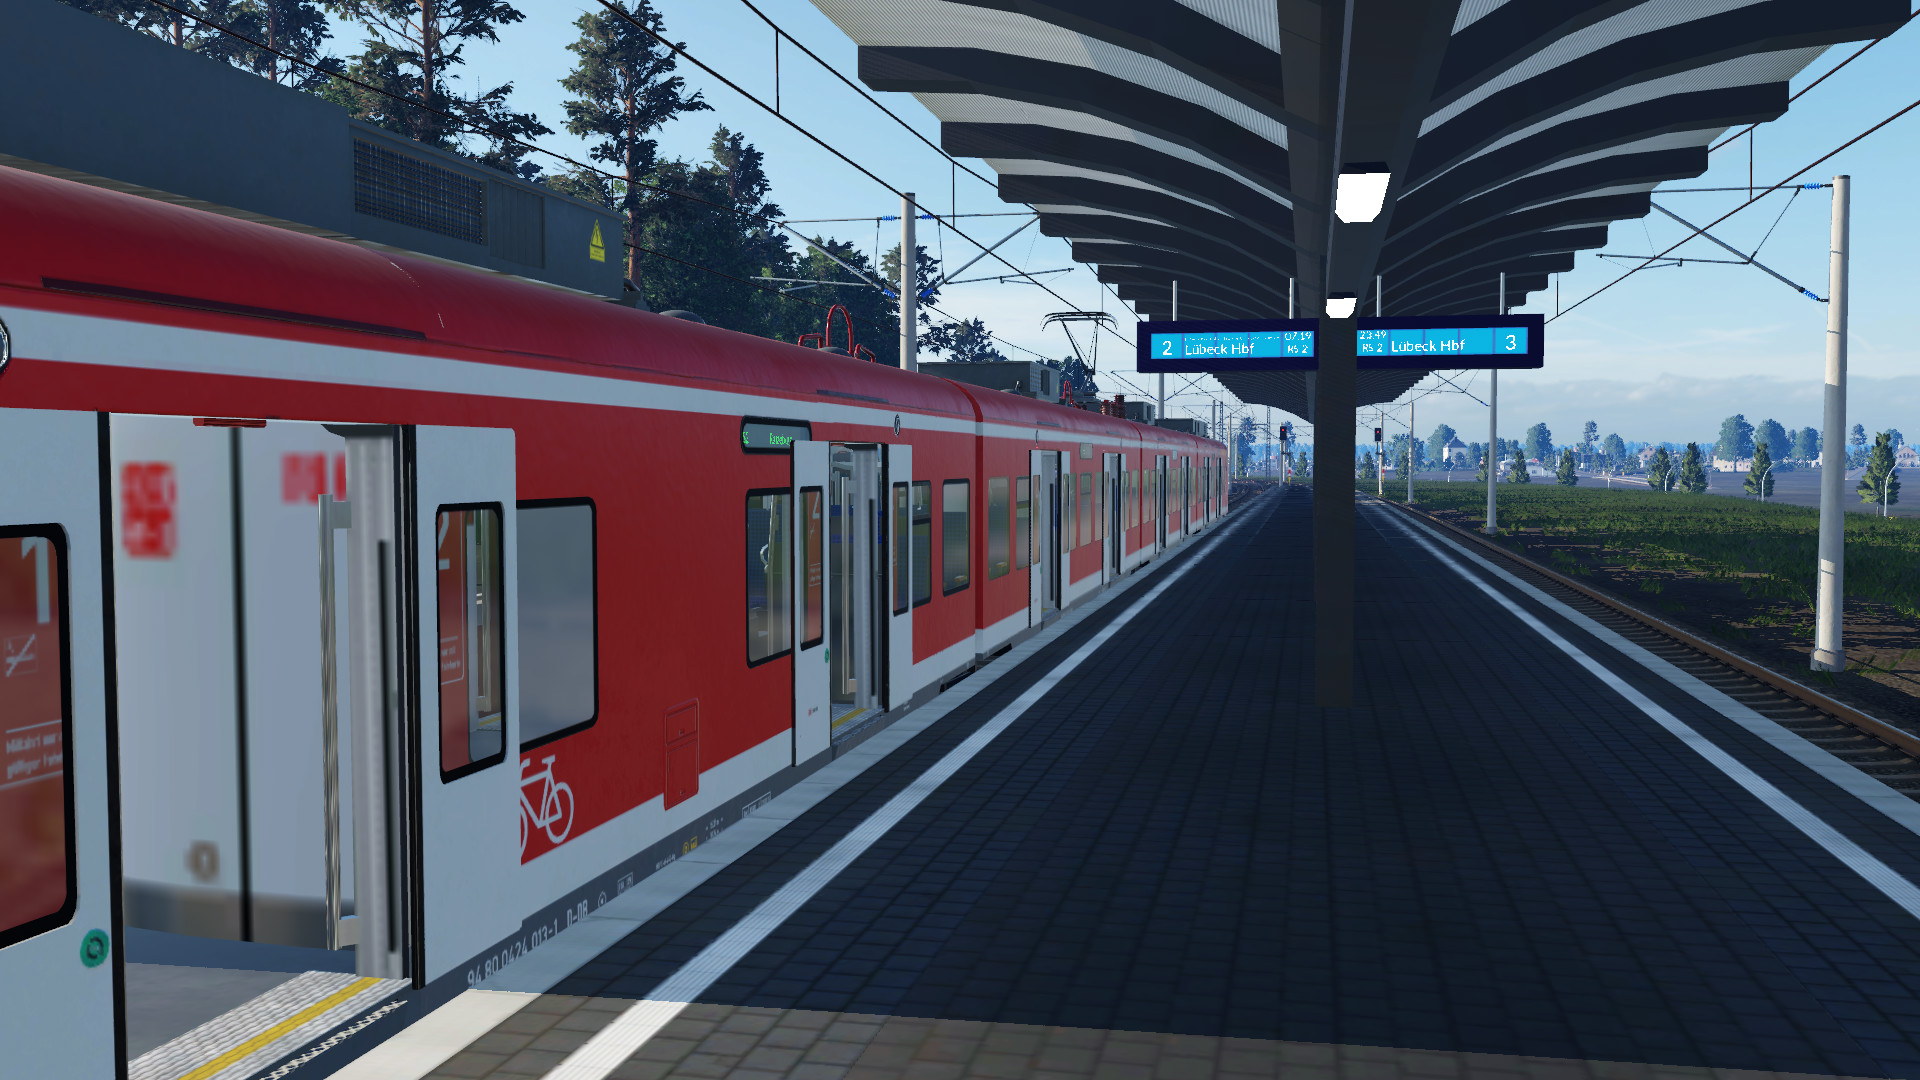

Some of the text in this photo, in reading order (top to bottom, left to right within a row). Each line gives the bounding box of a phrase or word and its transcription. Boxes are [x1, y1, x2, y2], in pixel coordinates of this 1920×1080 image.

[1284, 331, 1312, 341] 07.19
[1505, 334, 1517, 351] 3
[1162, 340, 1173, 356] 2
[1185, 342, 1255, 356] Lübeck Hbf
[1301, 344, 1309, 354] 2
[1376, 342, 1383, 353] 2
[1391, 338, 1466, 353] Lübeck Hbf
[21, 536, 51, 625] 1
[467, 965, 482, 988] 94
[484, 954, 499, 979] 80
[501, 936, 528, 968] 0424
[531, 917, 558, 949] 013-1
